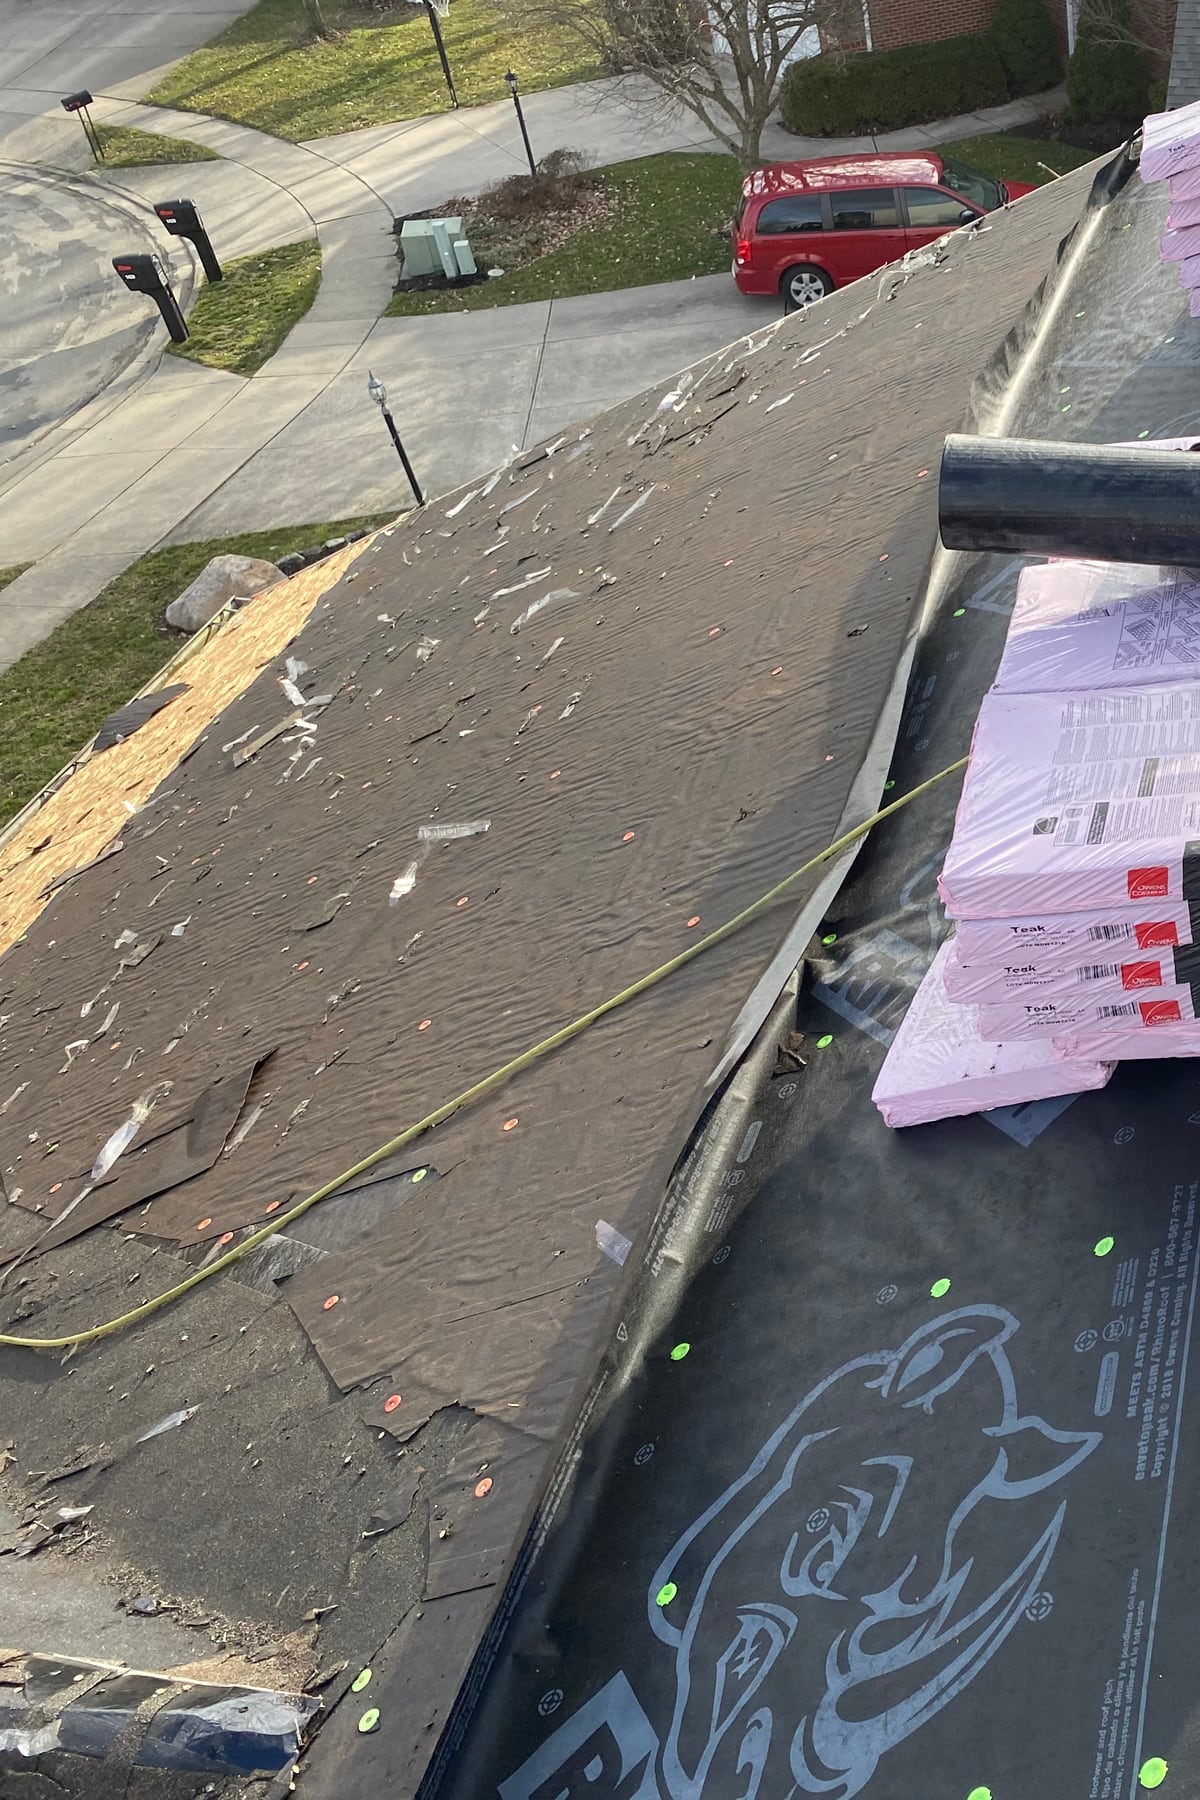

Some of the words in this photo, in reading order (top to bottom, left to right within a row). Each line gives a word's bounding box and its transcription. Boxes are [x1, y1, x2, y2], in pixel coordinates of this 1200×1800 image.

[1010, 925, 1046, 934] Teak
[1004, 965, 1036, 974] Teak
[1024, 1004, 1056, 1012] Teak
[1163, 1184, 1184, 1267] 800-567-9727
[1178, 1230, 1193, 1263] Rights
[1147, 1247, 1160, 1277] D226
[1176, 1265, 1187, 1279] All
[1133, 1332, 1148, 1368] ASTM
[1165, 1329, 1180, 1366] Owens
[1126, 1371, 1142, 1418] MEETS
[1160, 1369, 1174, 1399] 2018
[1150, 1416, 1169, 1478] Copyright
[1118, 1671, 1127, 1679] y
[1103, 1678, 1114, 1705] pitch
[1113, 1679, 1125, 1708] clima
[1101, 1706, 1111, 1728] roof
[1113, 1709, 1120, 1717] o
[1097, 1729, 1107, 1749] and
[1089, 1752, 1103, 1799] footwear
[1100, 1777, 1112, 1799] tipo
